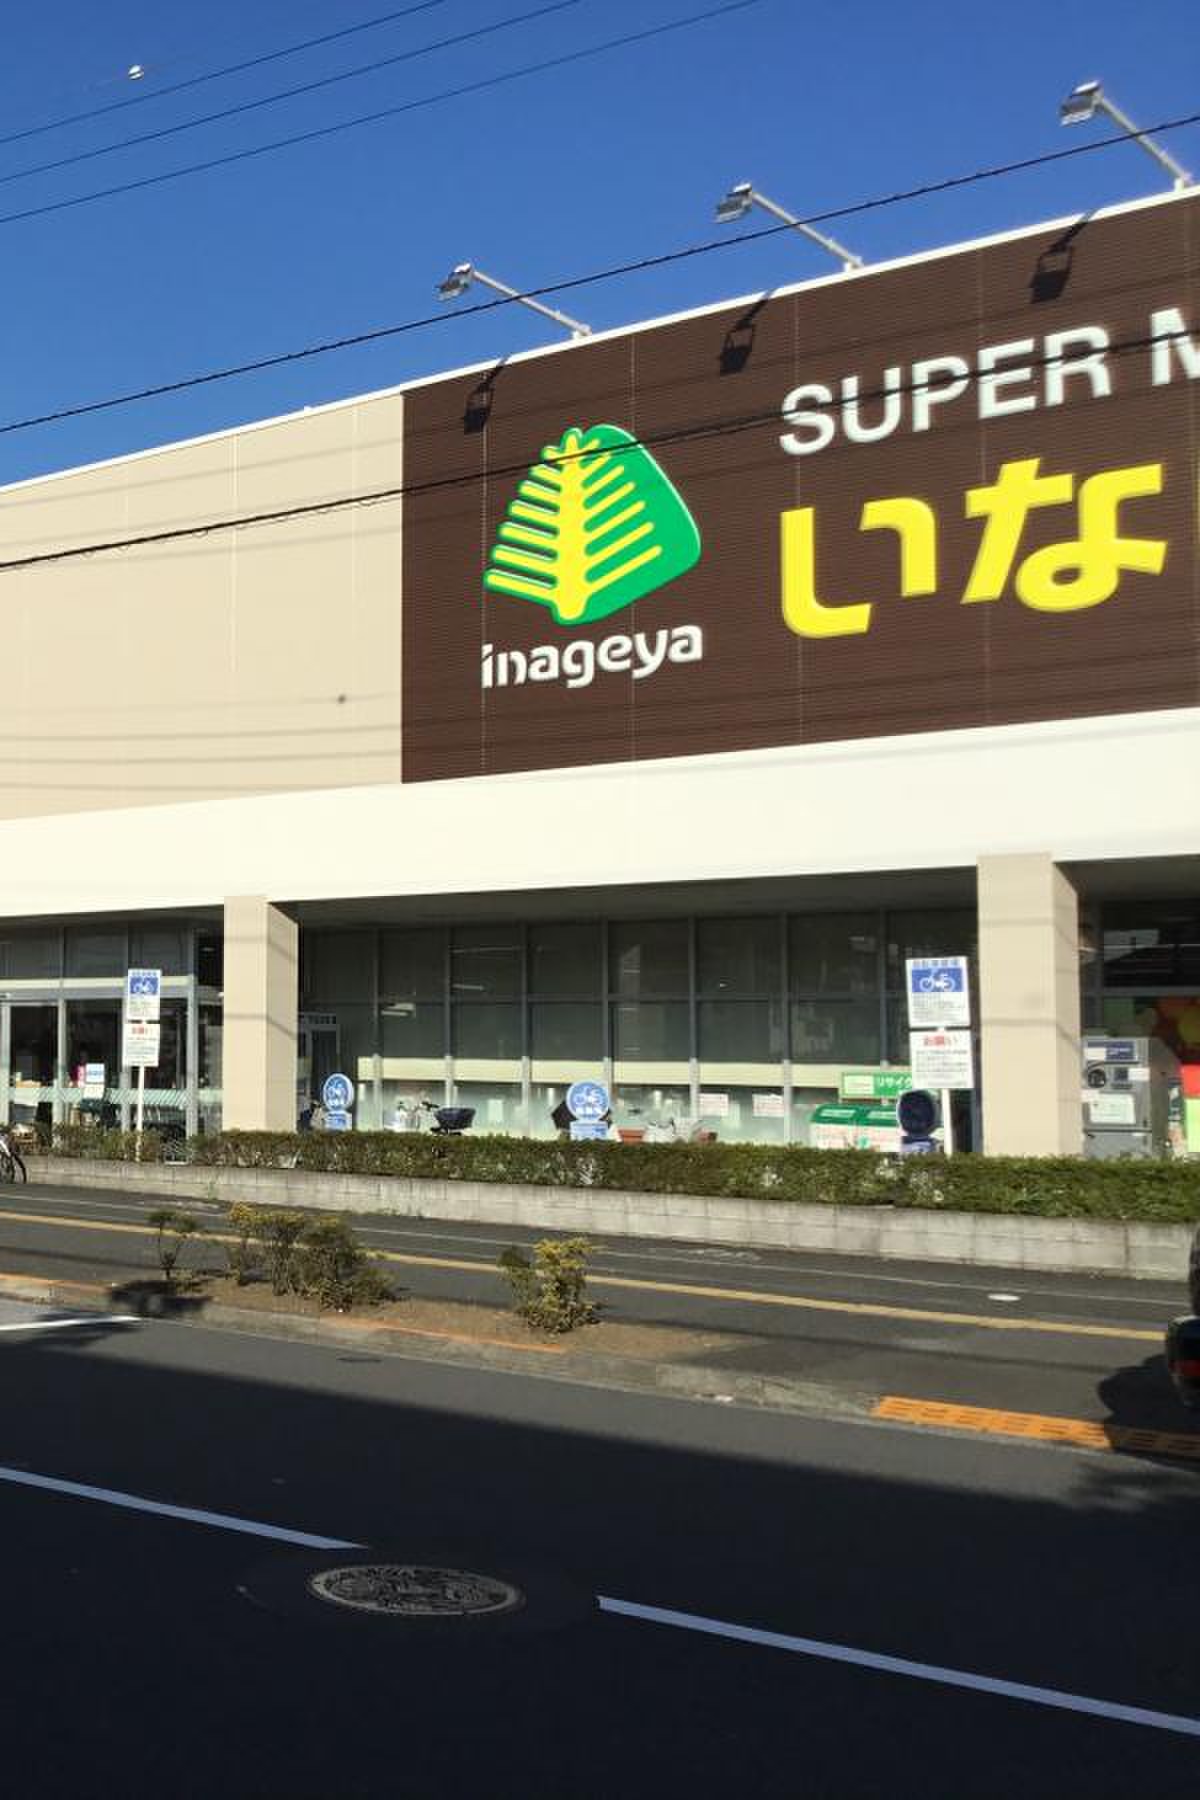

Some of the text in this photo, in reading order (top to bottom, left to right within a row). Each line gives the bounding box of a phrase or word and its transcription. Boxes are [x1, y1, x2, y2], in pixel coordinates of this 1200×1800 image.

[780, 326, 1111, 455] SUPER
[780, 458, 1167, 638] いな
[481, 624, 703, 688] inageya
